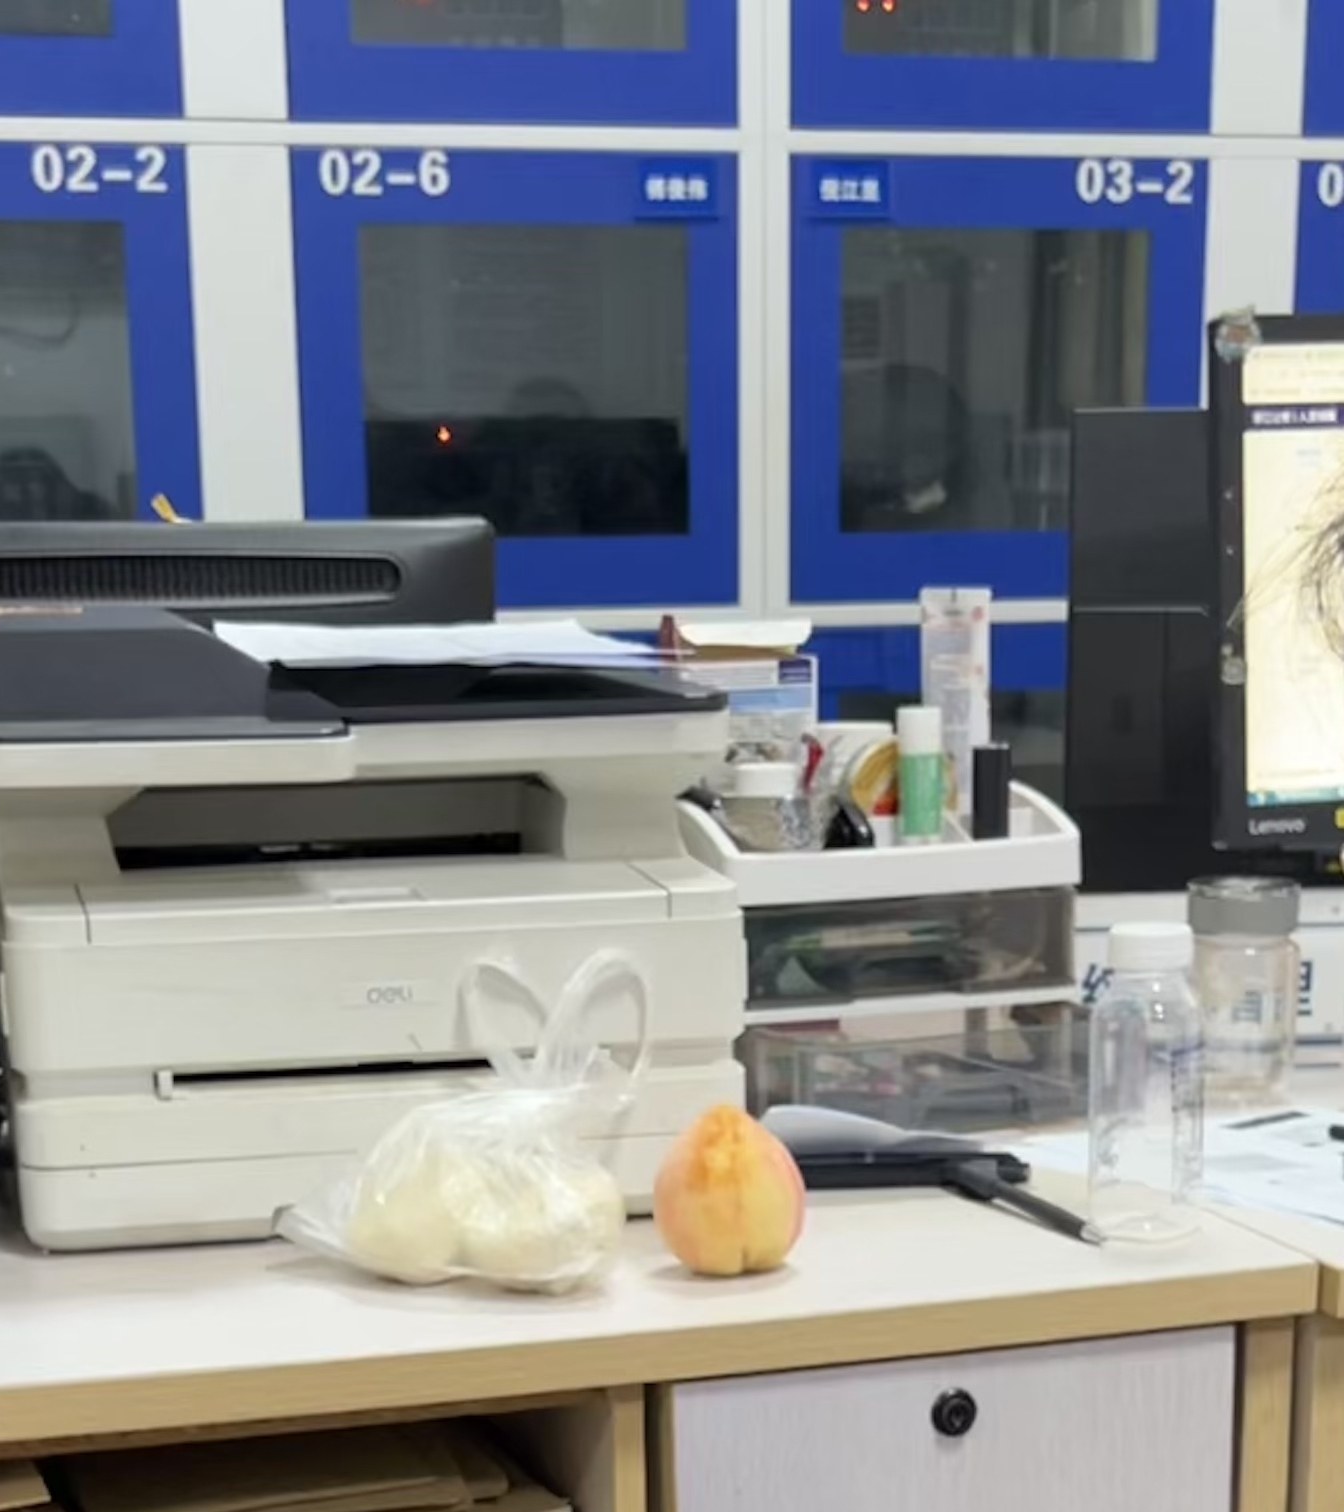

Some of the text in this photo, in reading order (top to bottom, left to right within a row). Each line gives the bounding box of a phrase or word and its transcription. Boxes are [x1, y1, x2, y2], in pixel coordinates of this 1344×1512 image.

[30, 144, 169, 195] 02-2
[317, 149, 452, 197] 02-6
[1075, 157, 1196, 206] 03-2
